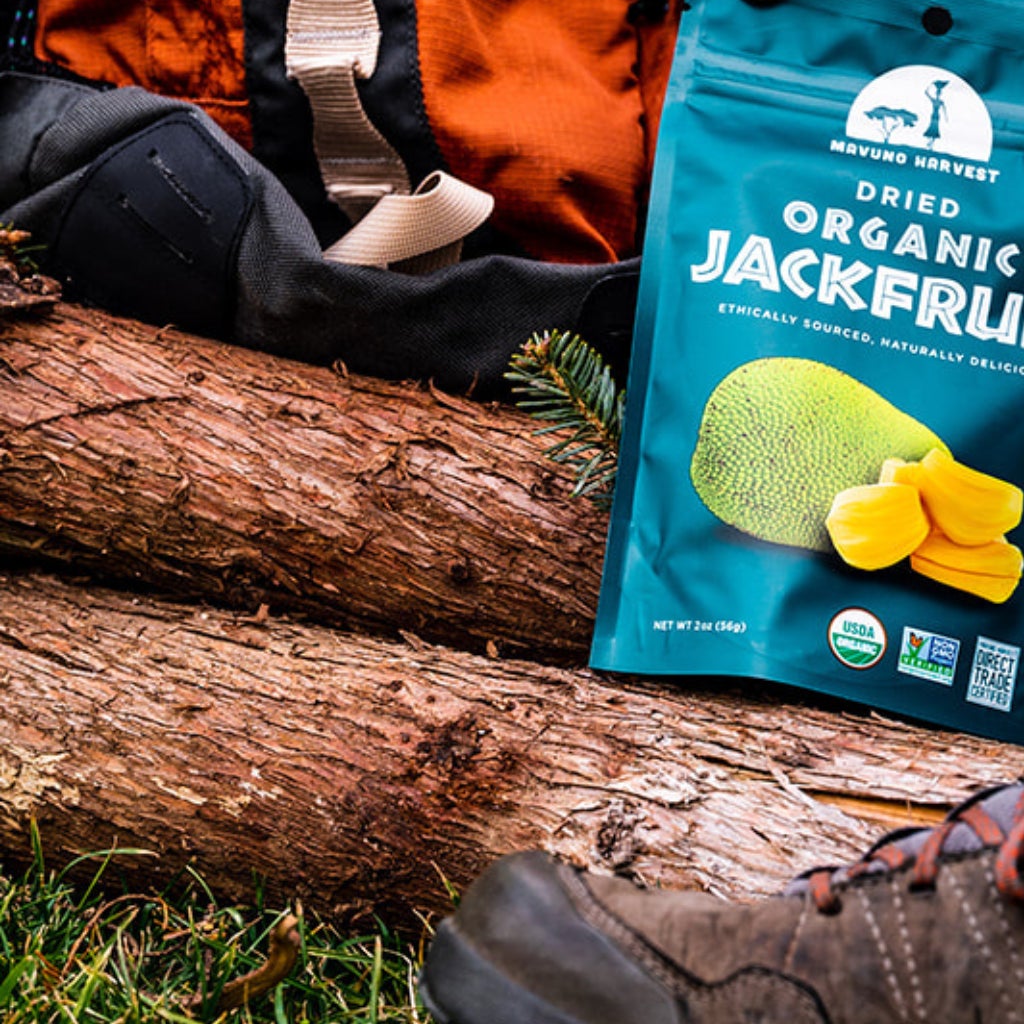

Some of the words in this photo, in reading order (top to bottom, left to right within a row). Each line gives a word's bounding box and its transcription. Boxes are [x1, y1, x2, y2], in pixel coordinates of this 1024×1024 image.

[829, 138, 908, 166] MAVUNO
[914, 154, 1000, 184] HARVEST
[855, 180, 961, 219] DRIED
[782, 200, 1021, 278] ORGANIC
[718, 302, 799, 326] ETHICALLY
[803, 318, 876, 347] SOURCED,
[880, 336, 965, 365] NATURALLY
[653, 620, 674, 632] NET
[676, 620, 692, 631] WT
[842, 619, 876, 640] USDA
[835, 636, 878, 656] ORGANIC
[977, 649, 1016, 674] DIRECT
[974, 666, 1013, 693] TRADE
